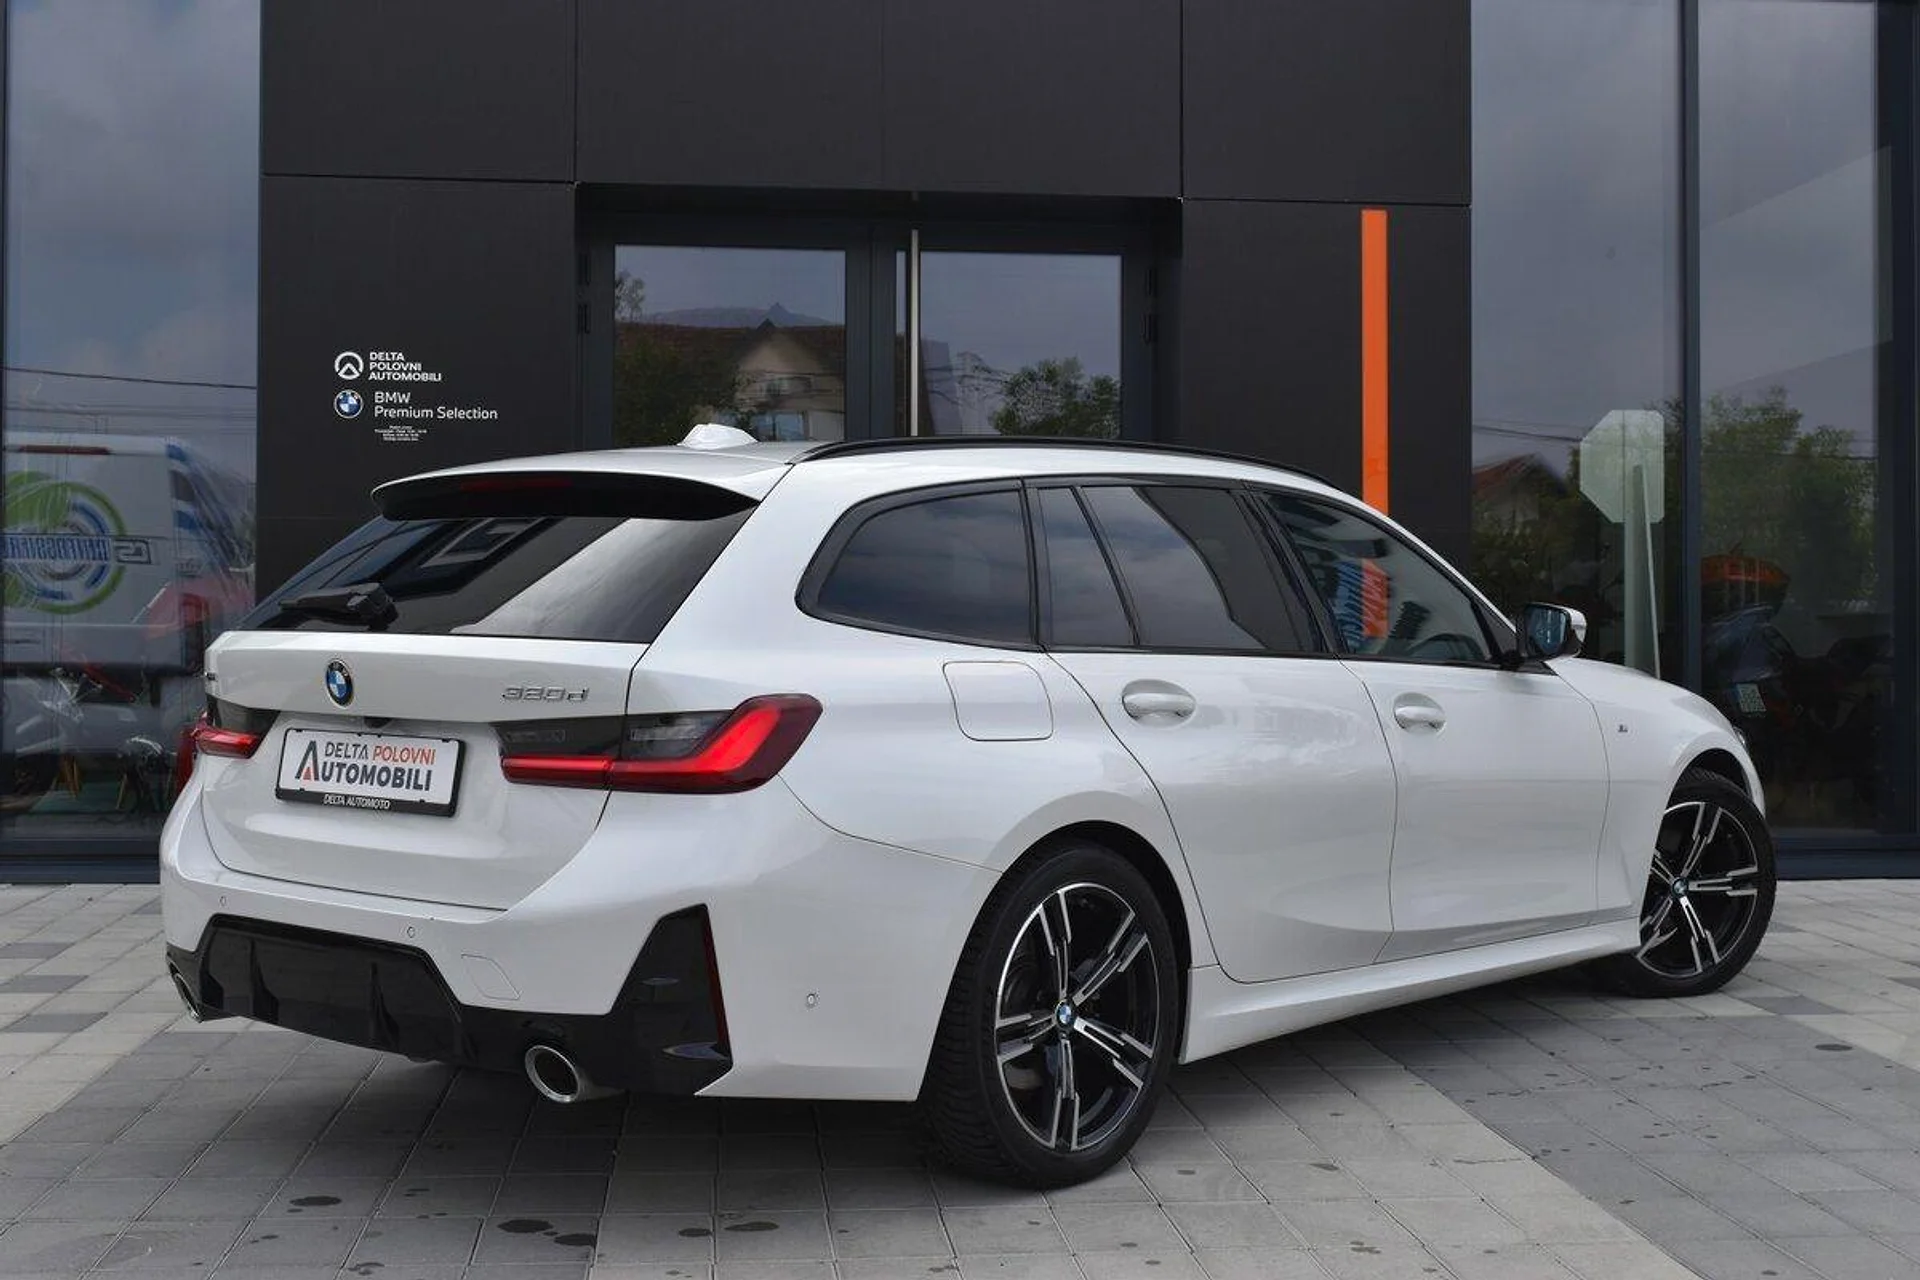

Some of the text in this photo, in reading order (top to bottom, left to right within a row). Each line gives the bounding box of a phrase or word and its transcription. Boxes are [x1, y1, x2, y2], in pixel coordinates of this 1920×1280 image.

[369, 352, 405, 361] DELTA
[369, 362, 422, 371] POLOVNI
[368, 372, 442, 382] AUTOMOBILI
[374, 391, 411, 403] BMW
[374, 405, 498, 420] Premium Selection
[324, 742, 436, 766] DELTA POLOVNI
[295, 740, 433, 792] AUTOMOBILI
[323, 793, 391, 810] DELTA AUTOMOTO
